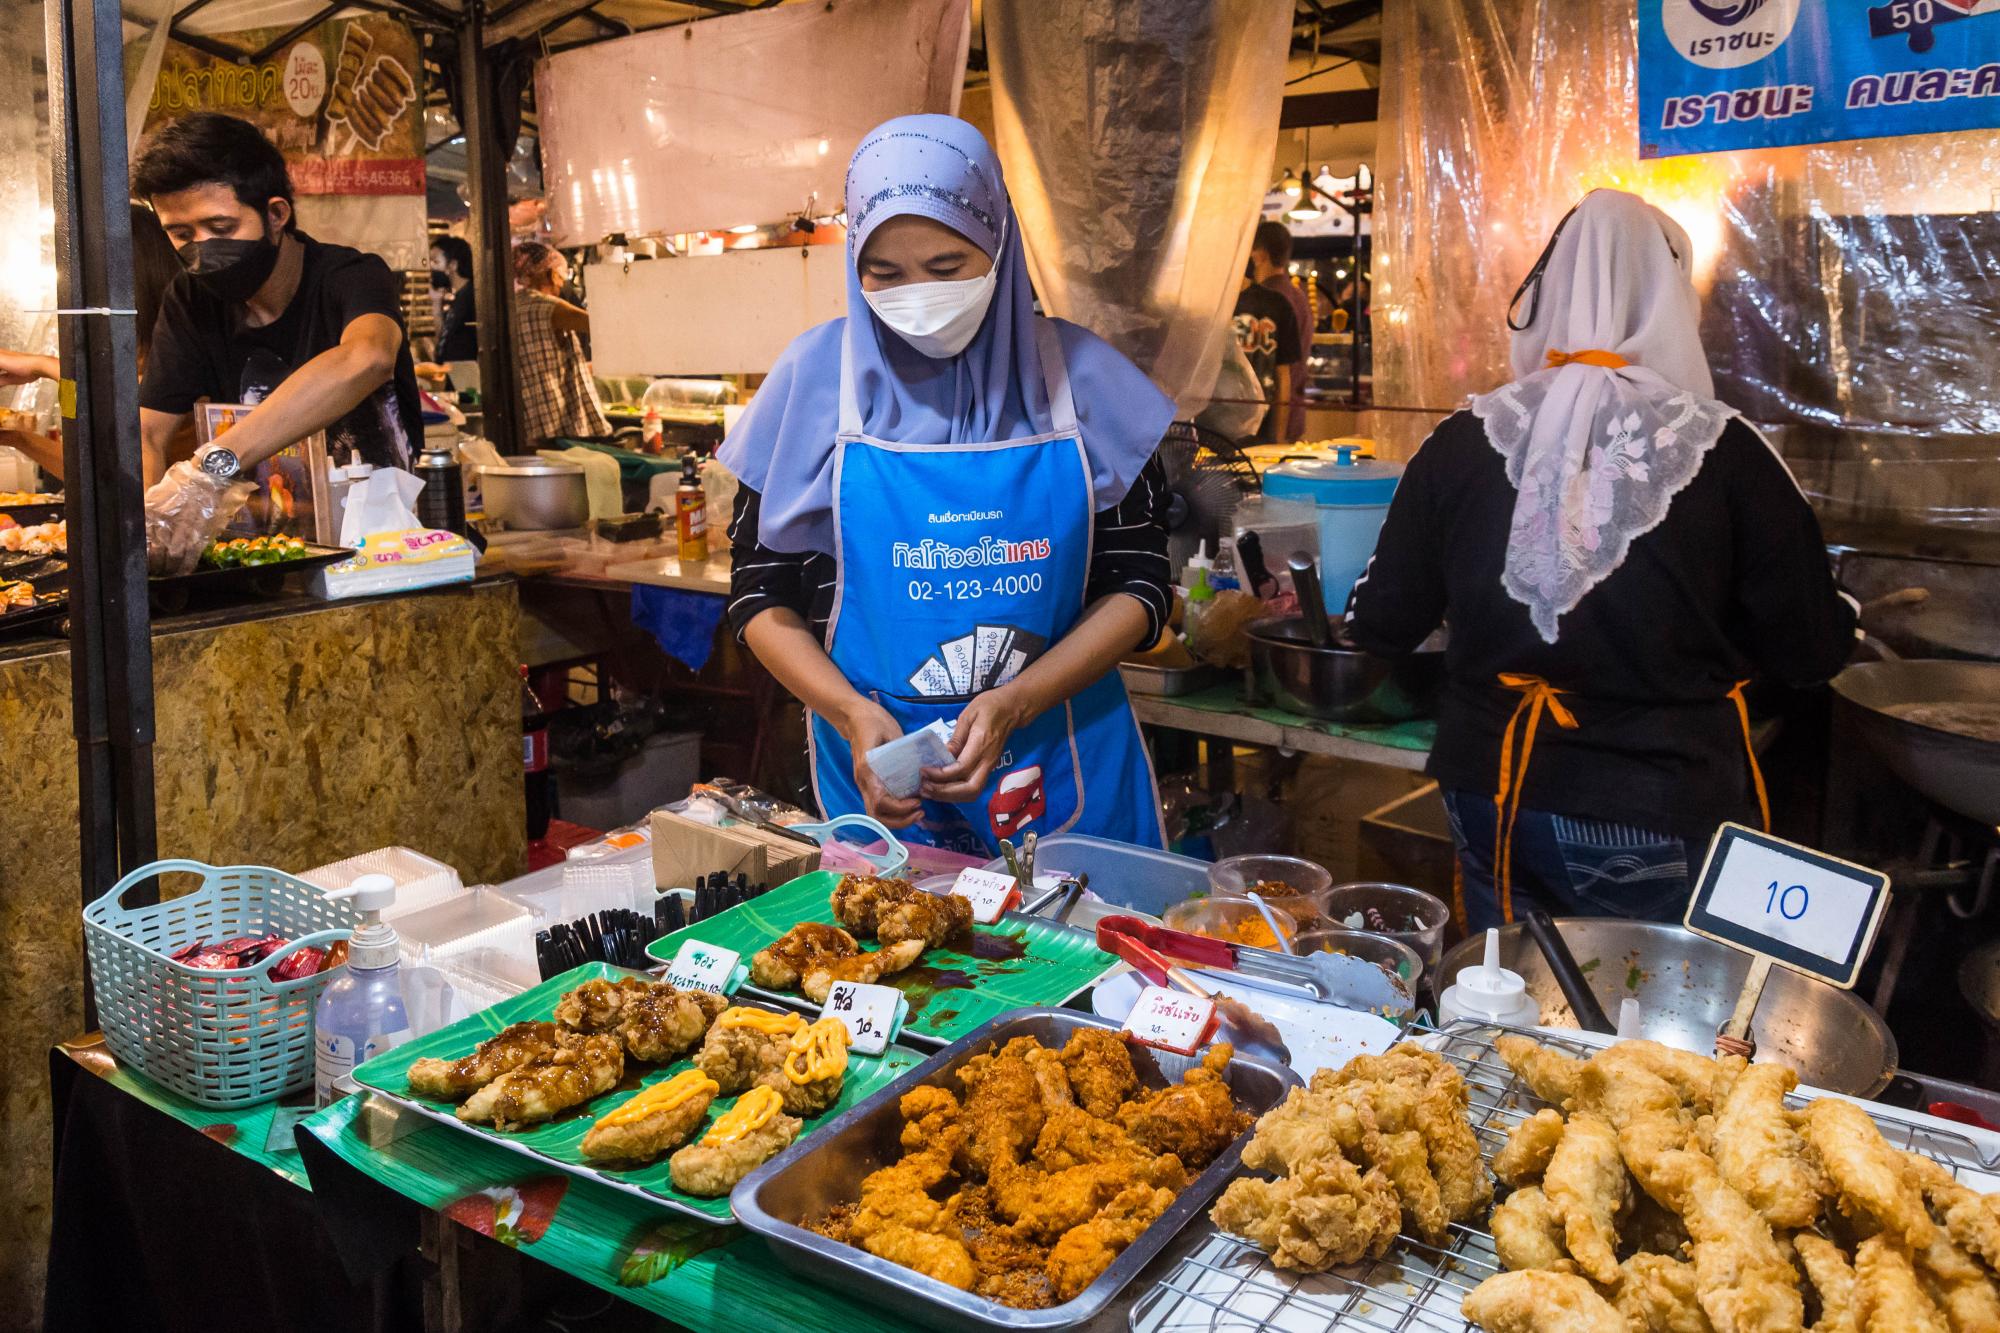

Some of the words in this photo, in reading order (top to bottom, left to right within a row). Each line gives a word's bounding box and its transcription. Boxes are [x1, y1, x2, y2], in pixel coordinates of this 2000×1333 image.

[1891, 0, 1934, 29] 50
[1689, 32, 1775, 56] เราชนะ
[1661, 85, 1814, 129] เราชนะ
[928, 510, 1003, 524] สินเชื่อทะเบียนรถ
[893, 536, 1051, 569] ทิสโก้ออโต้แคช
[908, 572, 1042, 601] 02-123-4000
[1765, 880, 1810, 921] 10
[855, 1017, 873, 1036] 10
